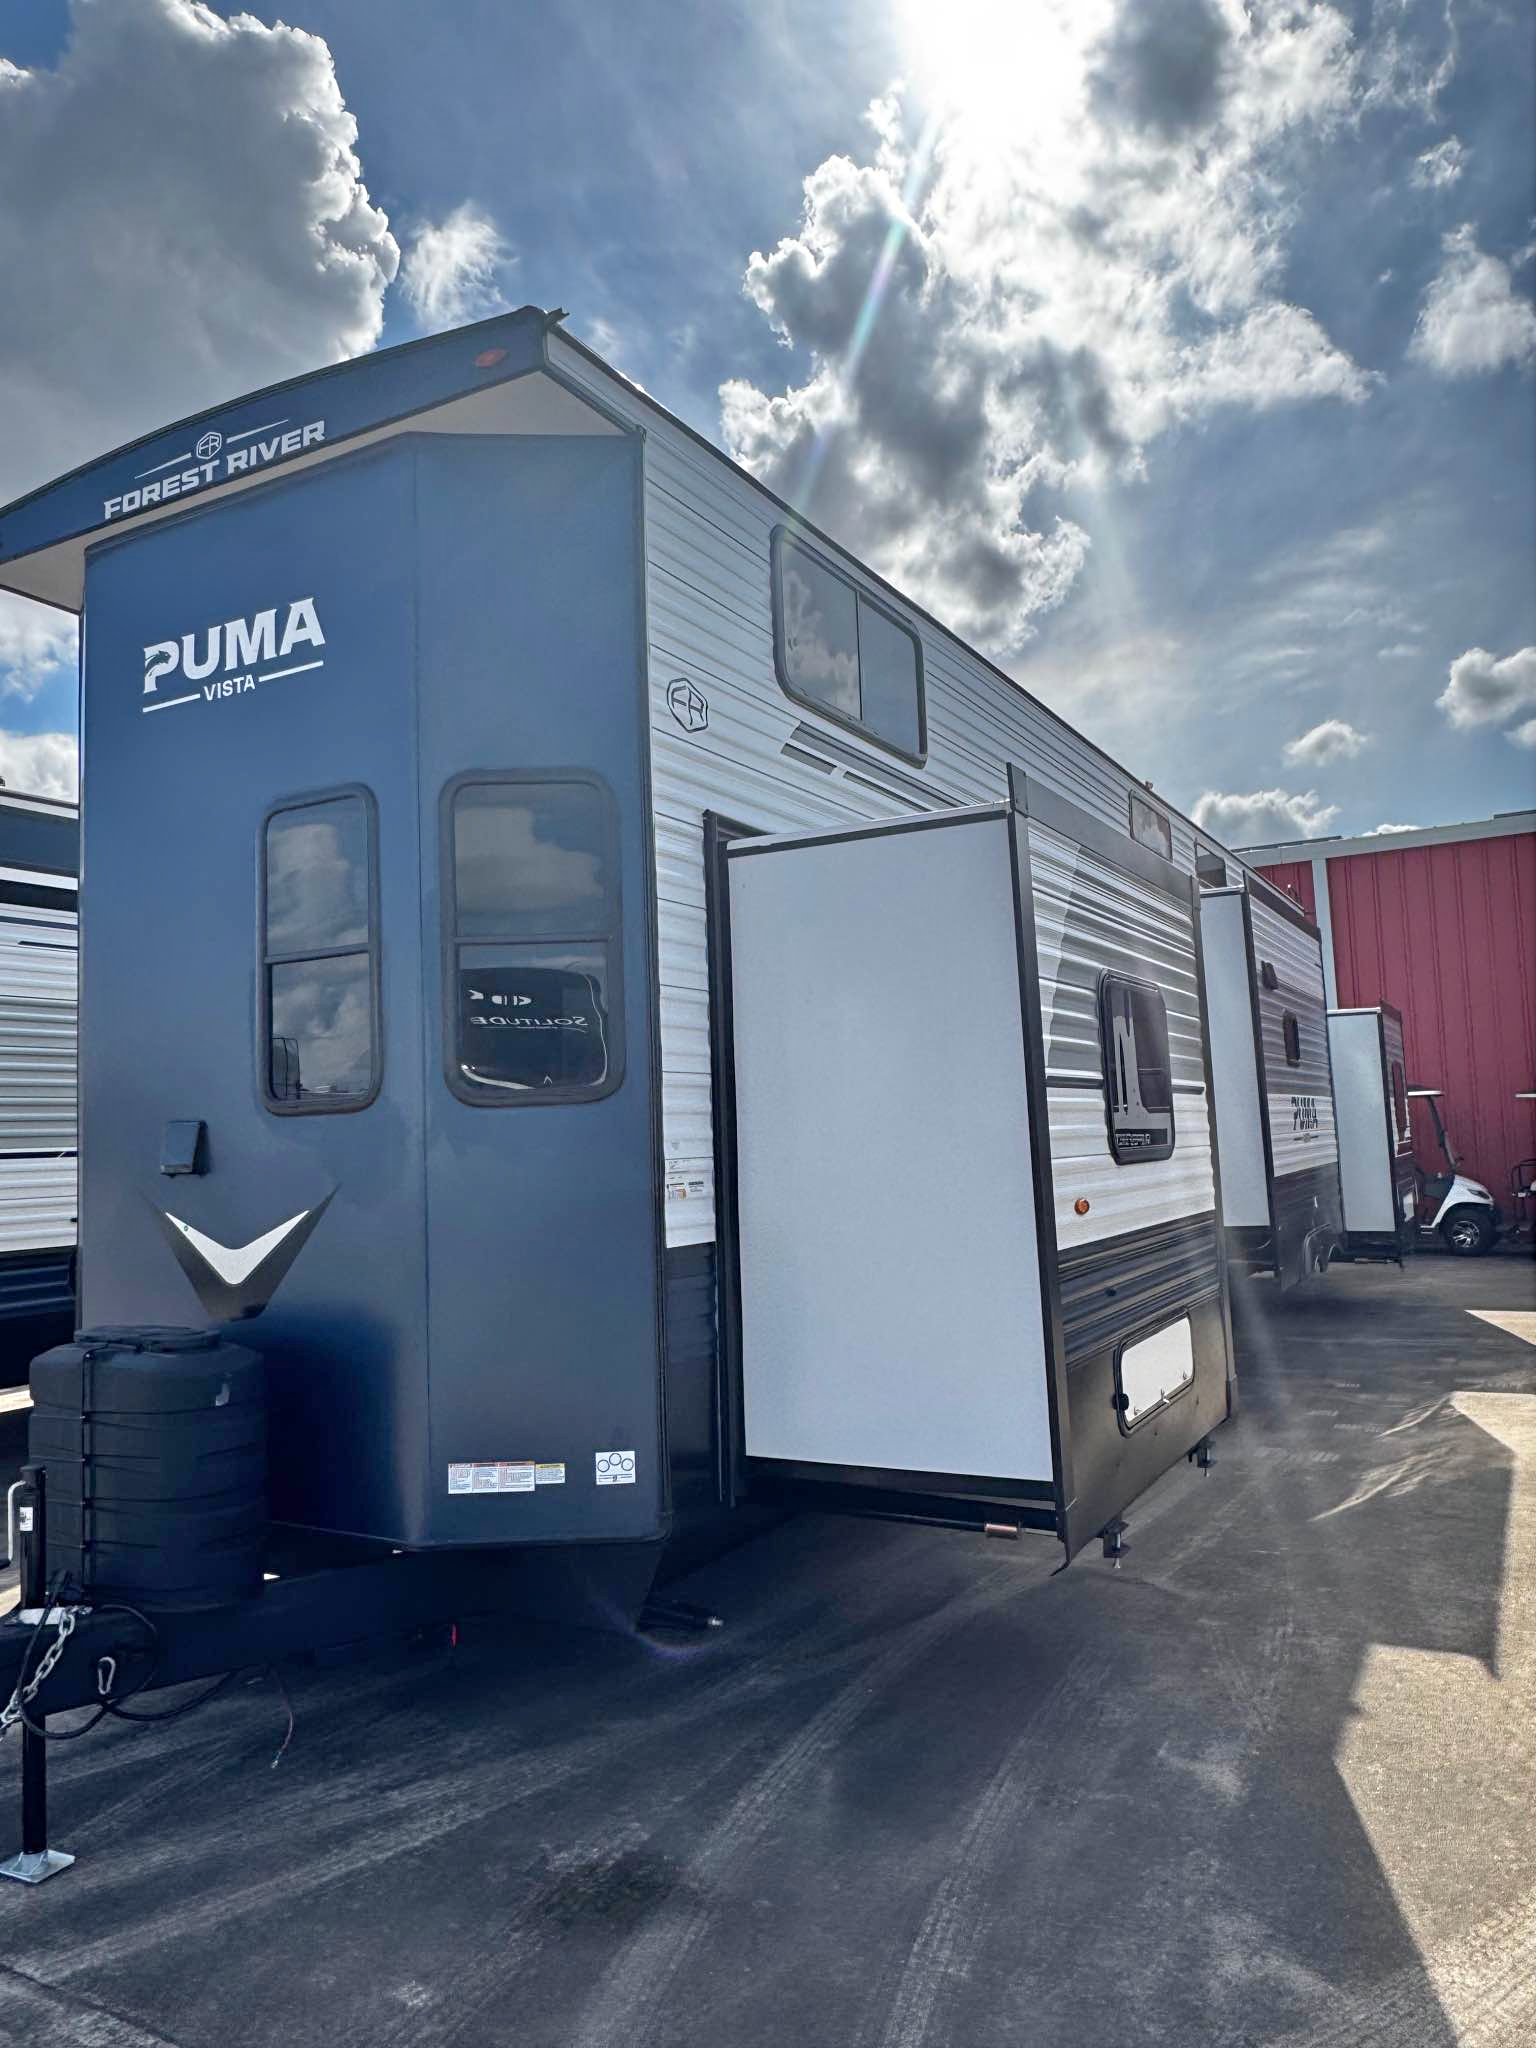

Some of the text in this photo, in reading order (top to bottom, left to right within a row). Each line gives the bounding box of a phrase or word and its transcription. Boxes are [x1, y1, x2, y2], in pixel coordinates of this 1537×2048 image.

[103, 421, 325, 519] FOREST RIVER
[143, 597, 326, 694] PUMA
[203, 674, 256, 701] VISTA
